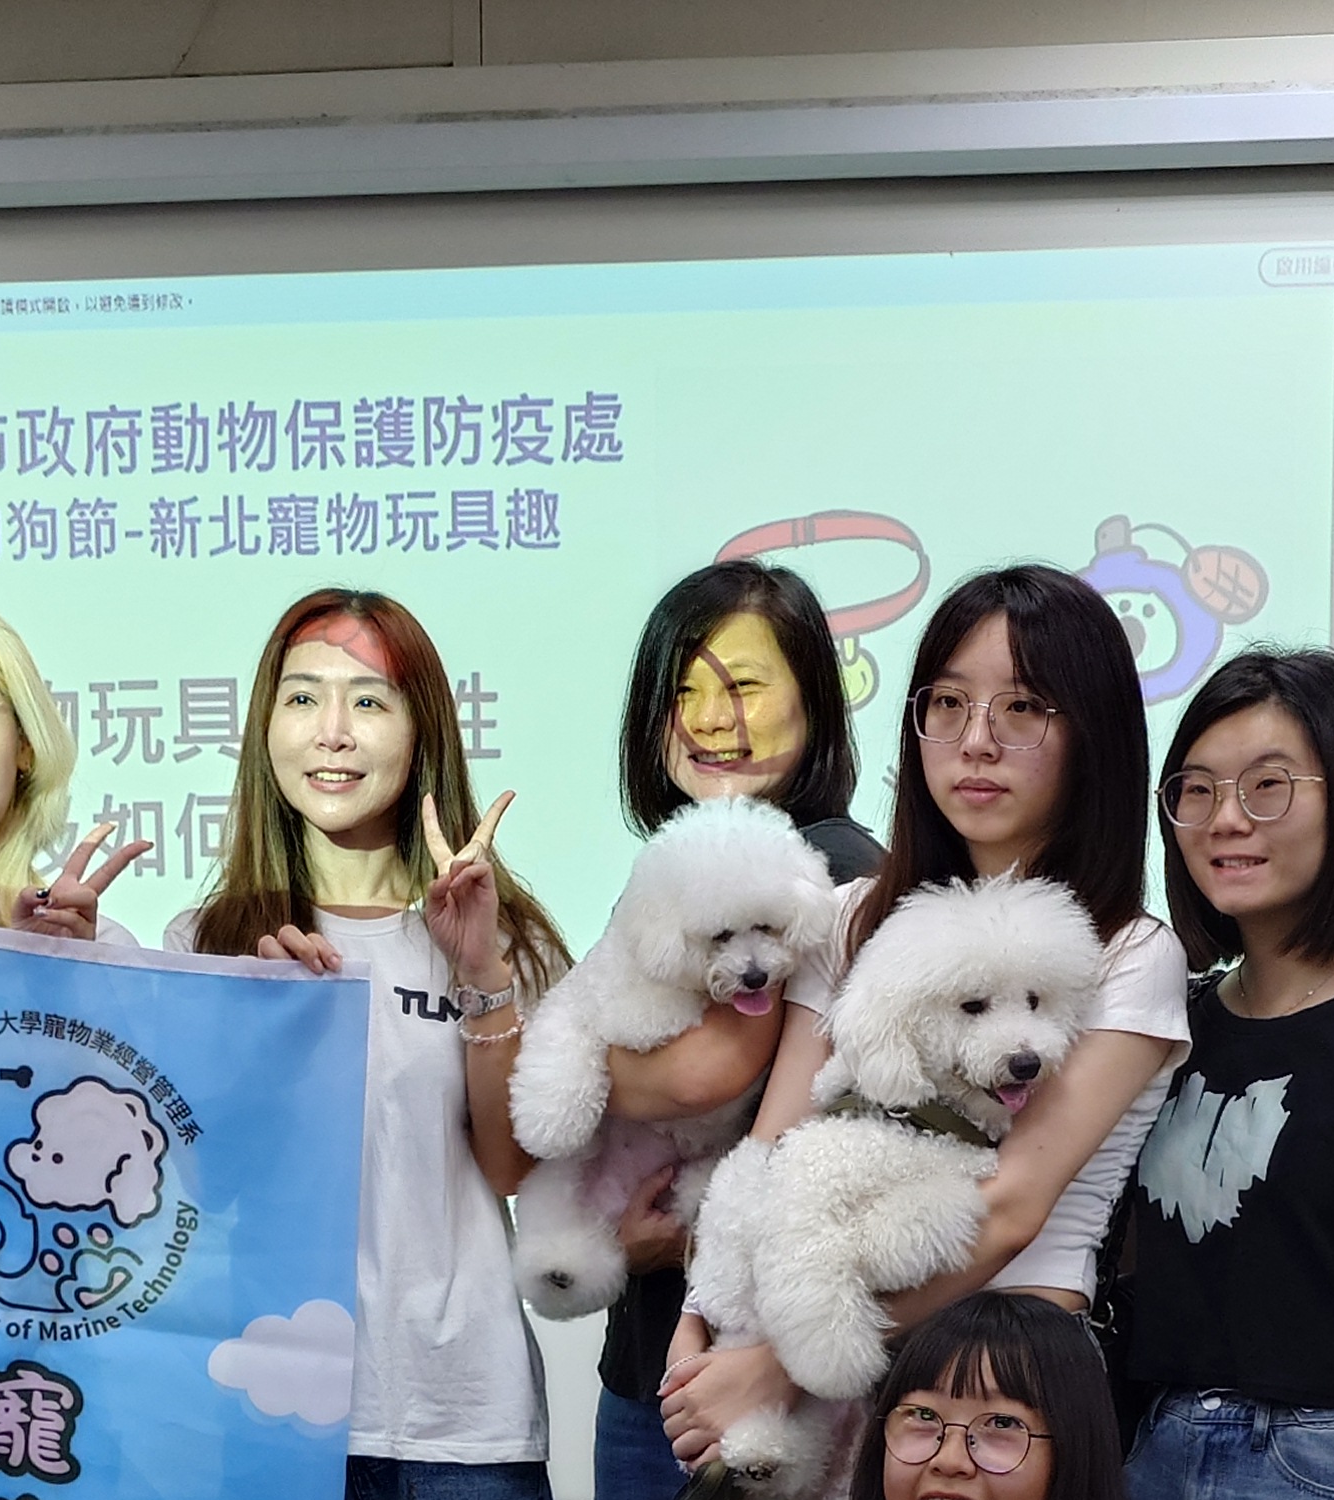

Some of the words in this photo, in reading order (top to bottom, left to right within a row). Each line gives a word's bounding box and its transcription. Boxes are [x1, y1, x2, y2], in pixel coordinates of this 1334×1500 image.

[6, 1318, 33, 1340] of
[39, 1314, 121, 1342] Marine
[117, 1200, 199, 1323] Technology
